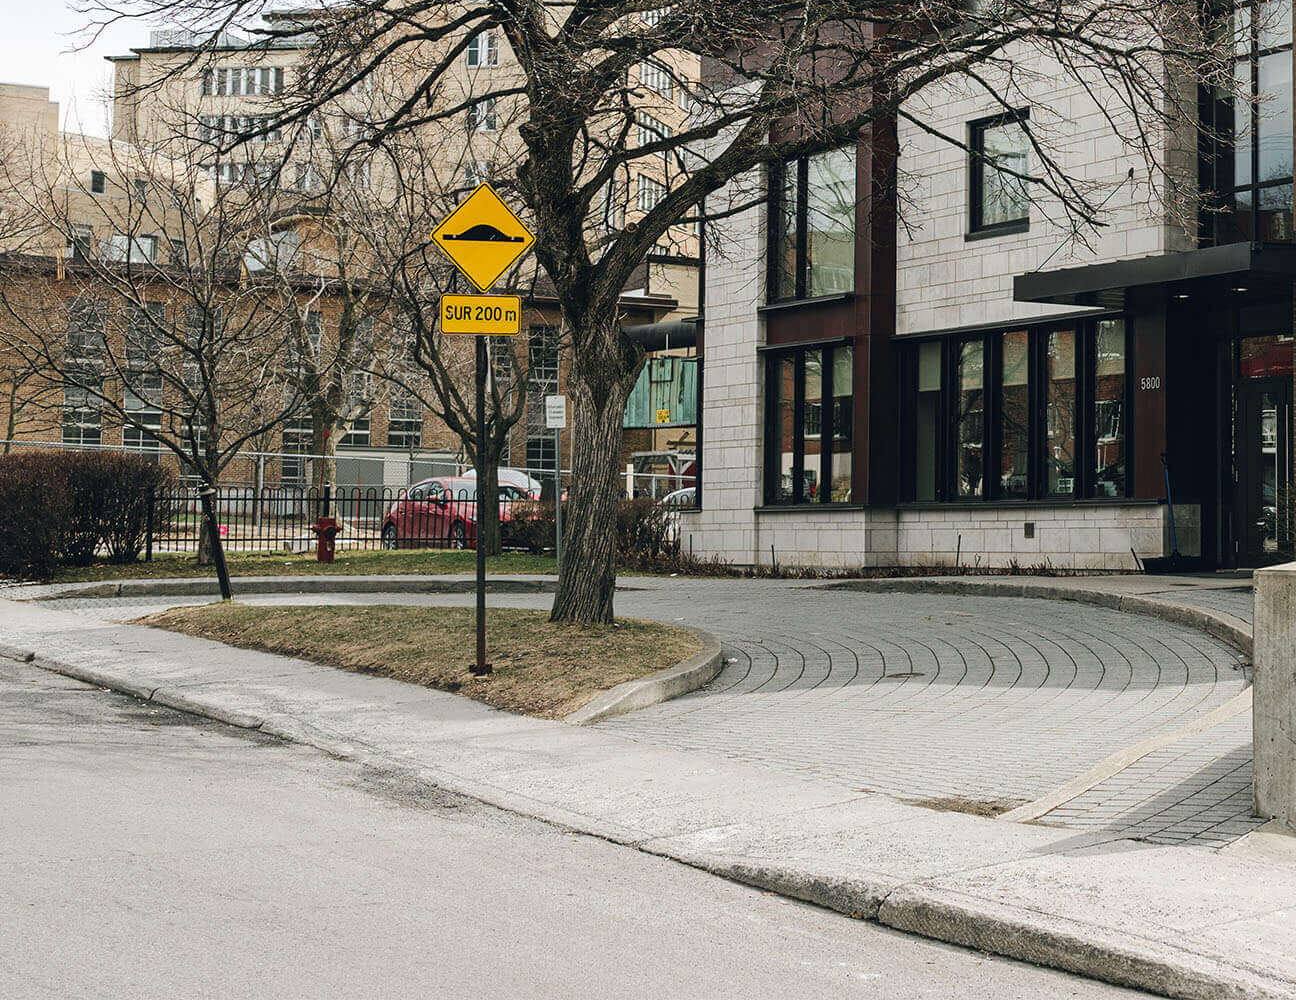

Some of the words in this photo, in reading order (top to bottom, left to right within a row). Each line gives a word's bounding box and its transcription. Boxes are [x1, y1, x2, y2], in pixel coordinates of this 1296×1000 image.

[446, 305, 472, 320] SUR
[475, 306, 502, 321] 200
[505, 310, 517, 321] m
[1141, 376, 1161, 390] 5800
